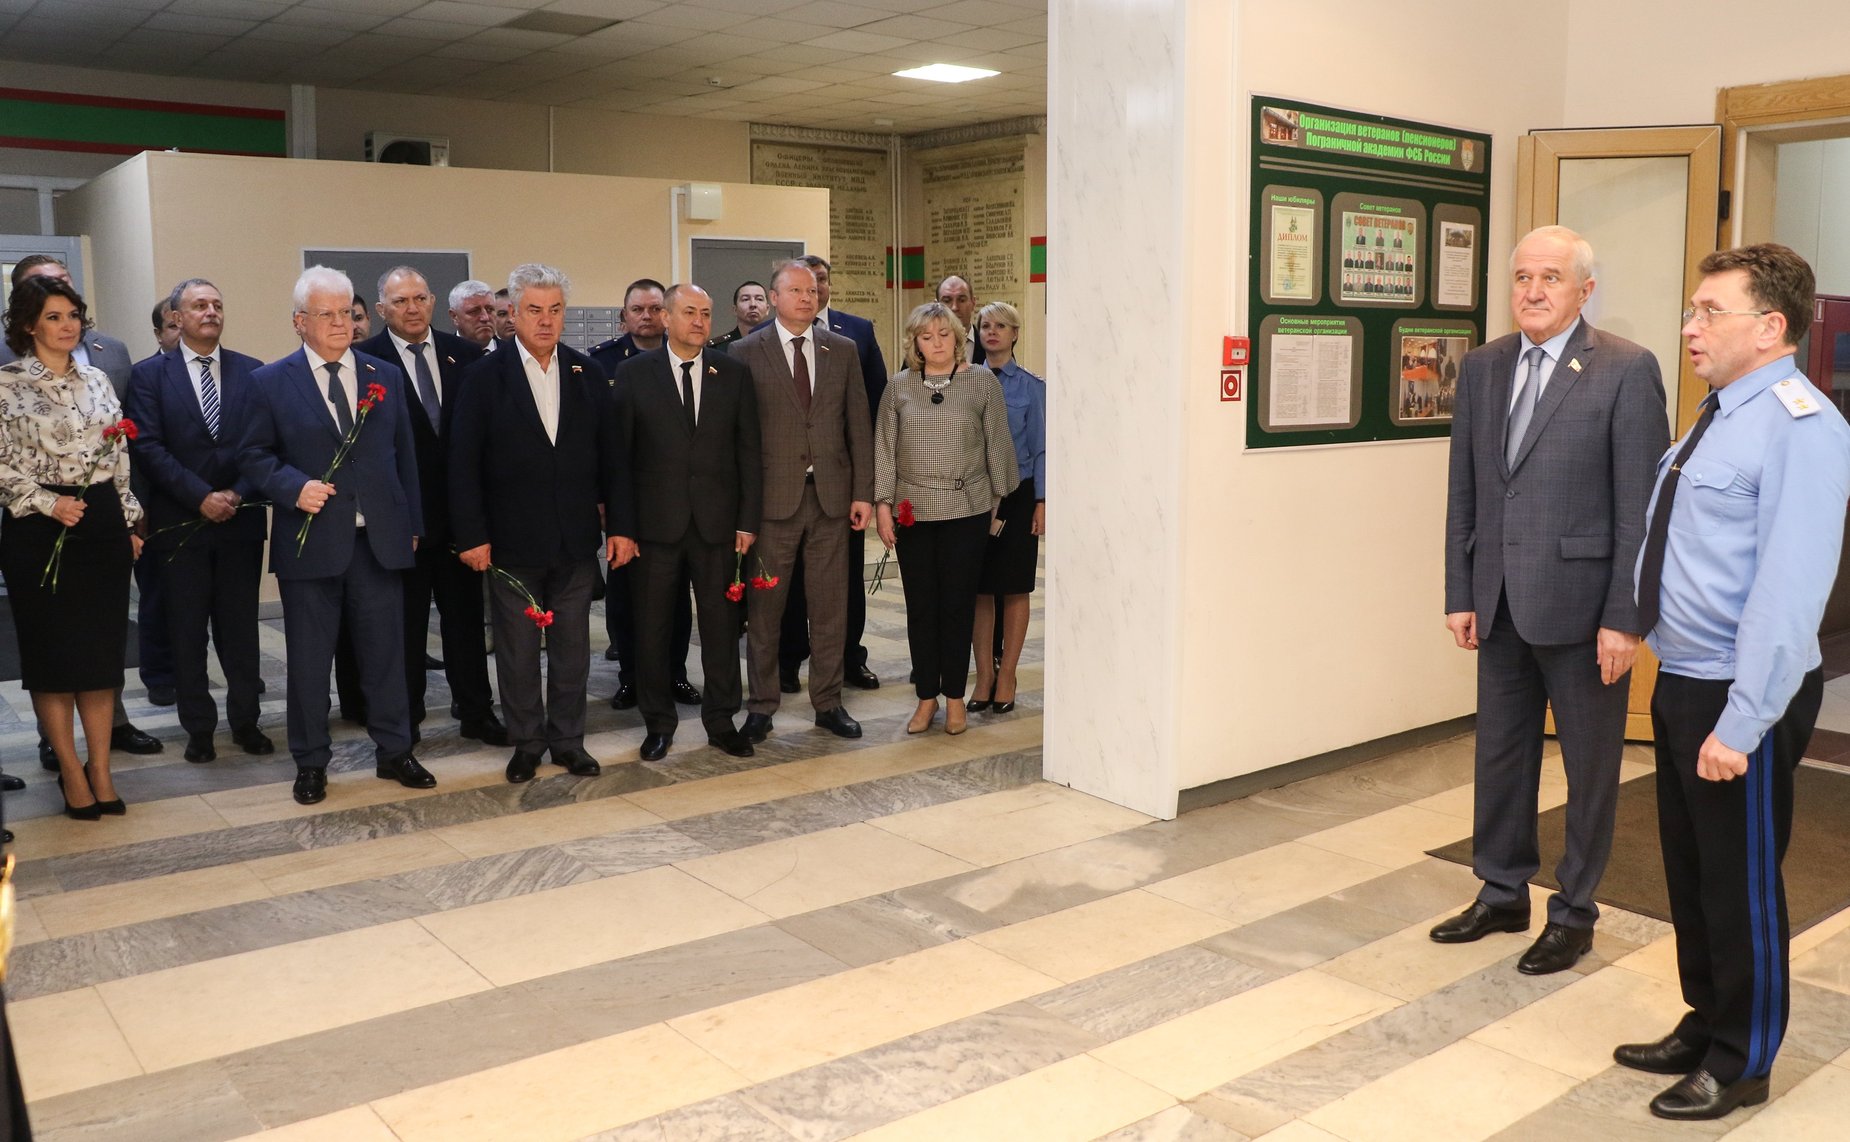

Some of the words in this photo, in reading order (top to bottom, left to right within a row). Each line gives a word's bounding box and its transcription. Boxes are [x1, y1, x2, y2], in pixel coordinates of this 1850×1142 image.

[1299, 113, 1357, 136] Организация
[1357, 125, 1400, 142] ветеранов
[1402, 129, 1457, 151] (пенсионеров)
[1306, 131, 1362, 153] Пограничной
[1363, 142, 1404, 159] академии
[1405, 147, 1423, 161] ФСБ
[1424, 149, 1451, 165] России
[1360, 203, 1375, 211] Совет
[1354, 215, 1373, 227] СОВЕТ
[1277, 232, 1308, 242] ДИПЛОМ
[1280, 317, 1309, 325] Основные
[1277, 327, 1313, 335] ветеранской
[1313, 328, 1348, 336] организации
